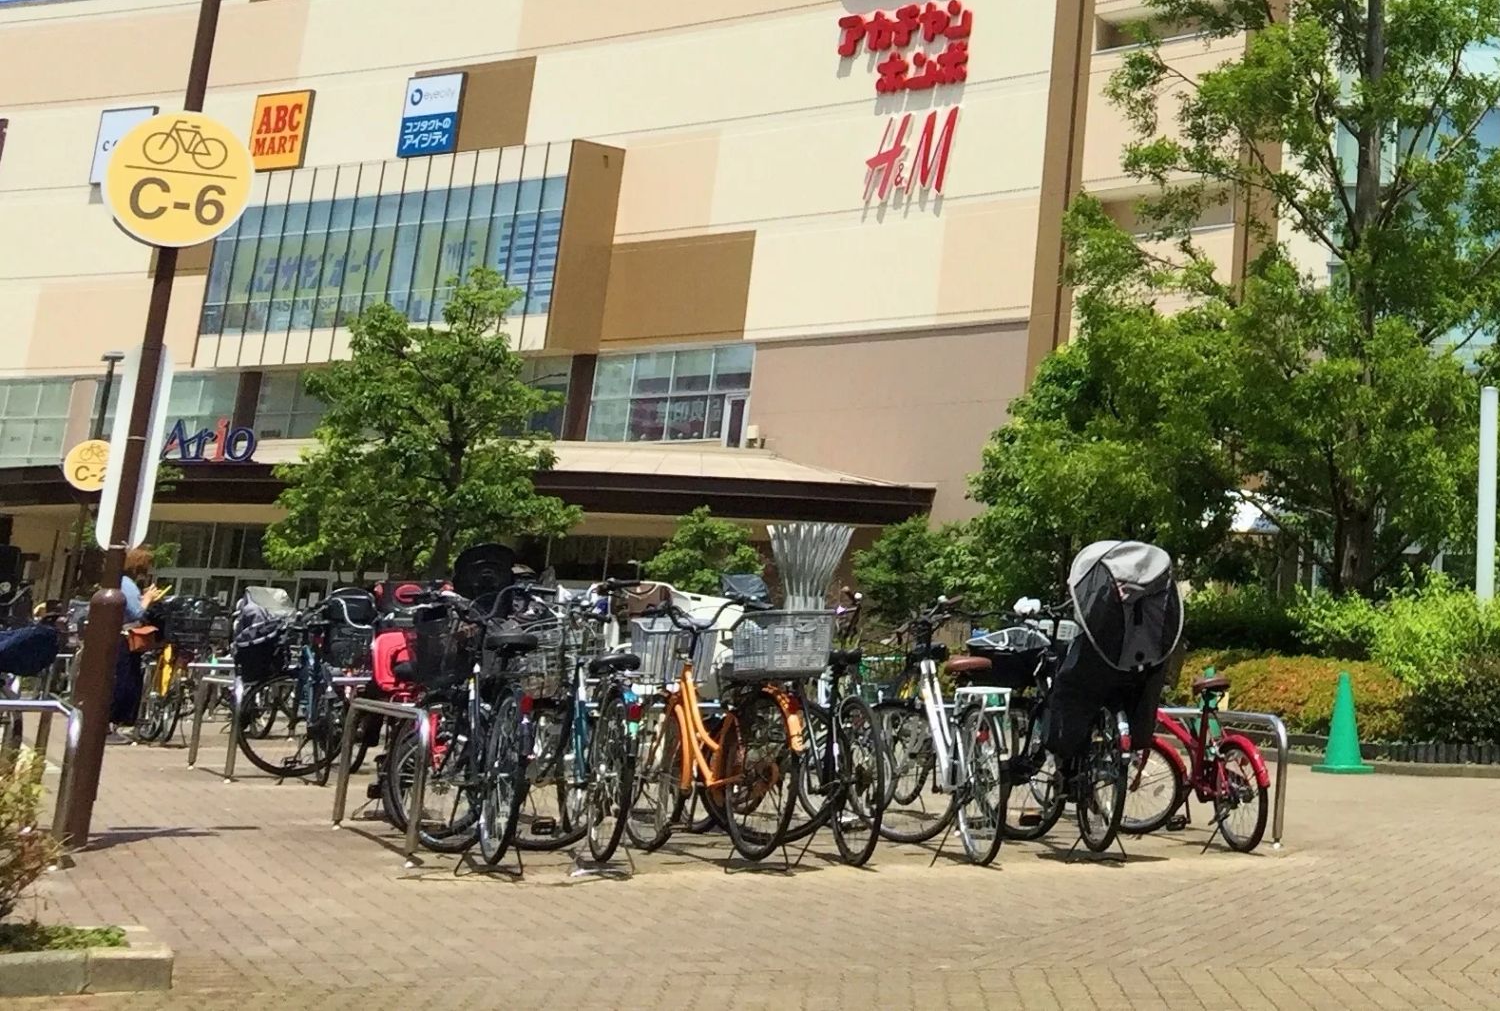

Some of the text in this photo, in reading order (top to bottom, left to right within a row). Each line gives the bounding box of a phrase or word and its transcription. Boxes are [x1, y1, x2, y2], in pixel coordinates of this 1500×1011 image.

[838, 0, 973, 57] アカチャン
[257, 103, 303, 135] ABC
[405, 117, 452, 134] コンタクトの
[252, 134, 299, 158] MART
[402, 131, 450, 150] アイシティ
[863, 106, 960, 201] H&M
[129, 177, 226, 226] C-6
[160, 414, 257, 462] Ario
